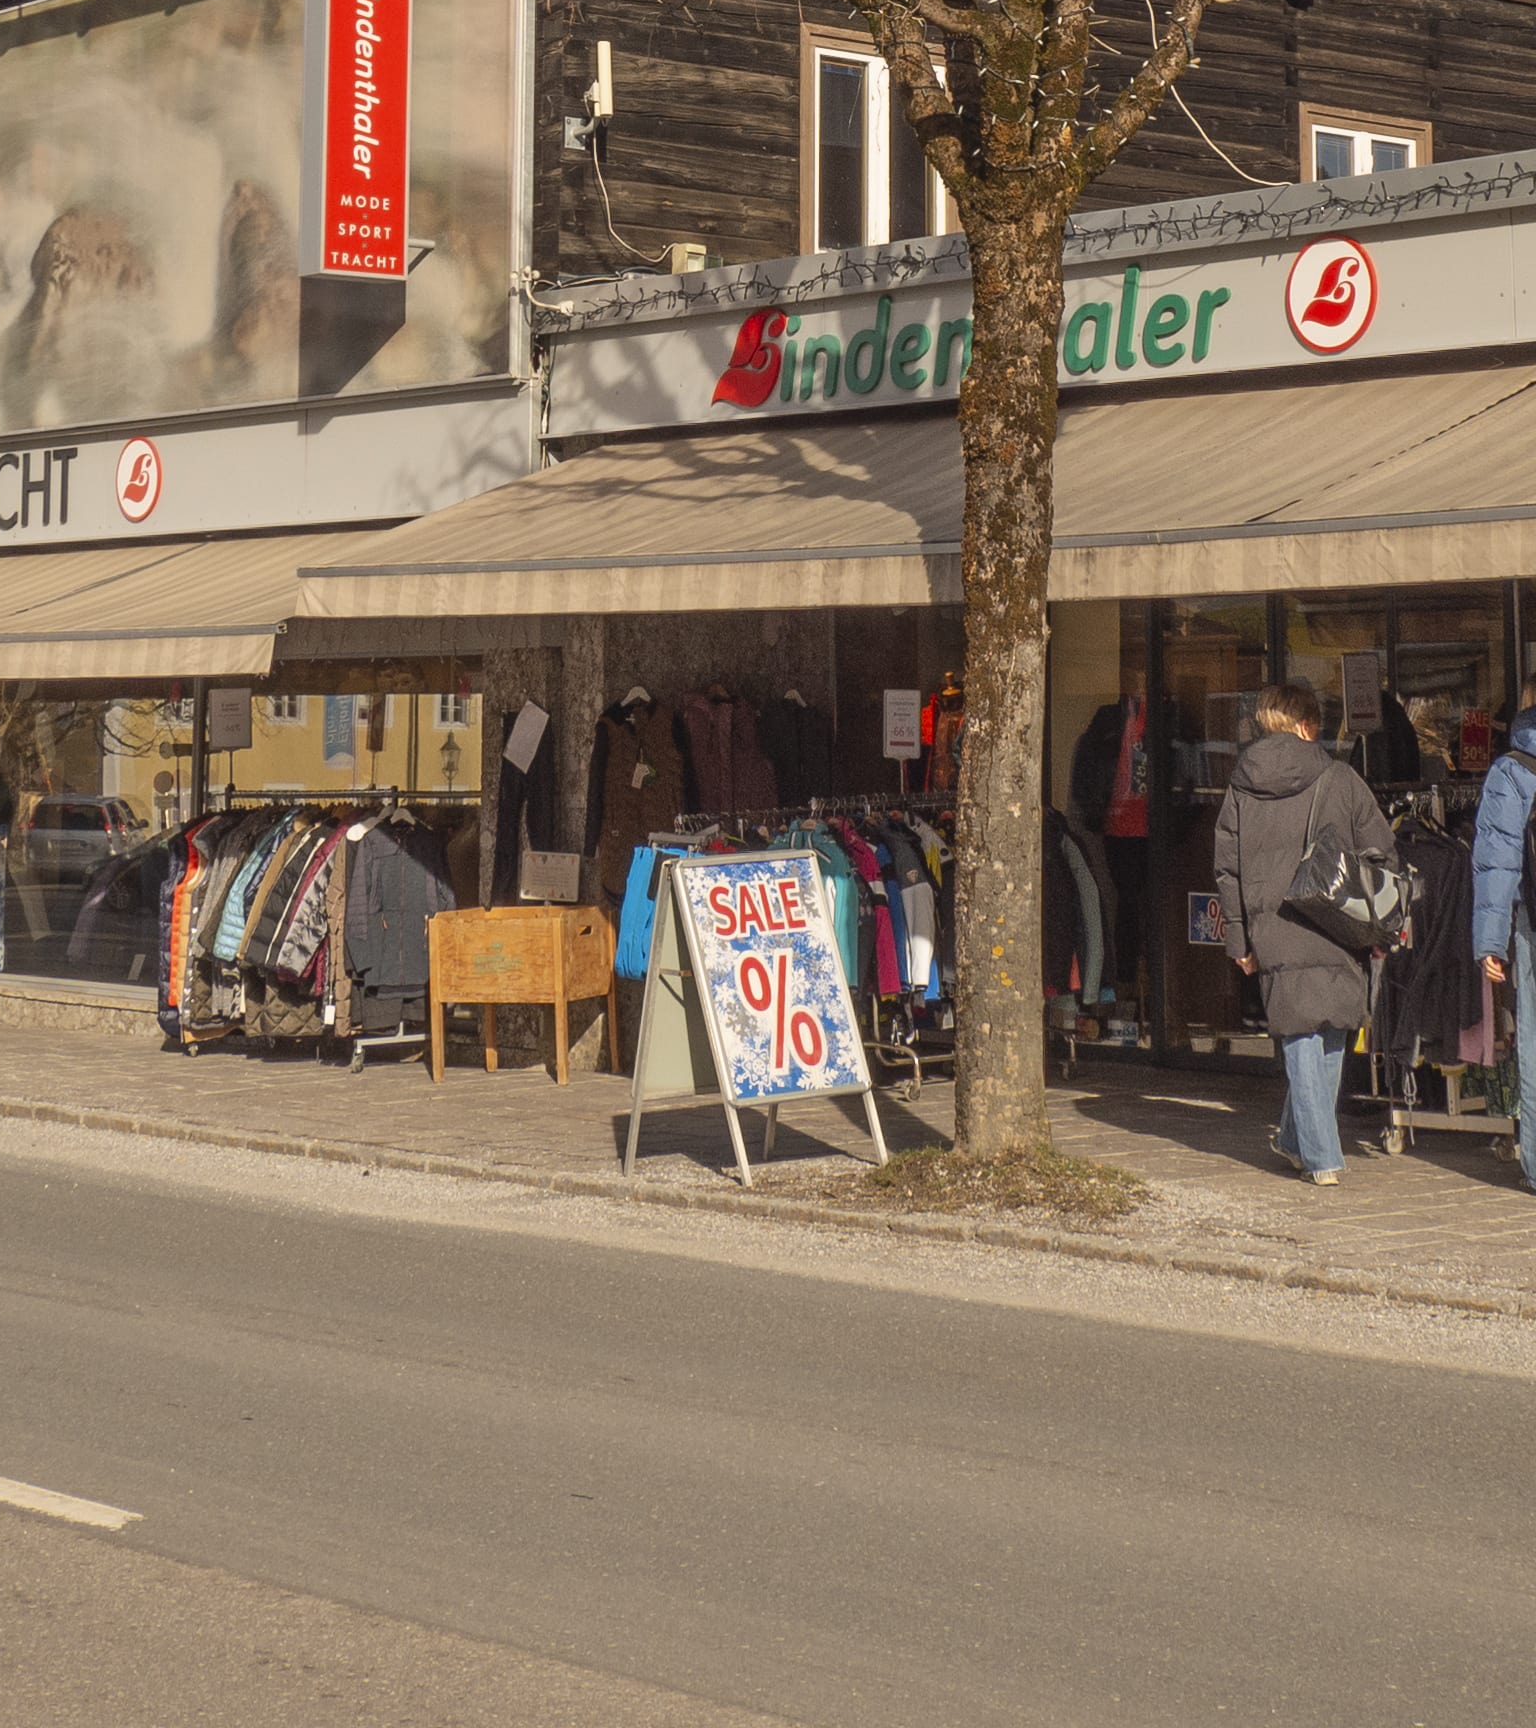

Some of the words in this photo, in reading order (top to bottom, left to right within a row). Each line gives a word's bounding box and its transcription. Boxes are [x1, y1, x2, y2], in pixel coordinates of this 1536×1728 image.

[340, 194, 391, 211] MODE
[338, 222, 392, 240] SPORT
[331, 251, 398, 270] TRACHT
[711, 263, 1232, 410] Lindenaler
[1464, 711, 1489, 727] SALE
[709, 881, 807, 936] SALE
[740, 954, 823, 1070] %
